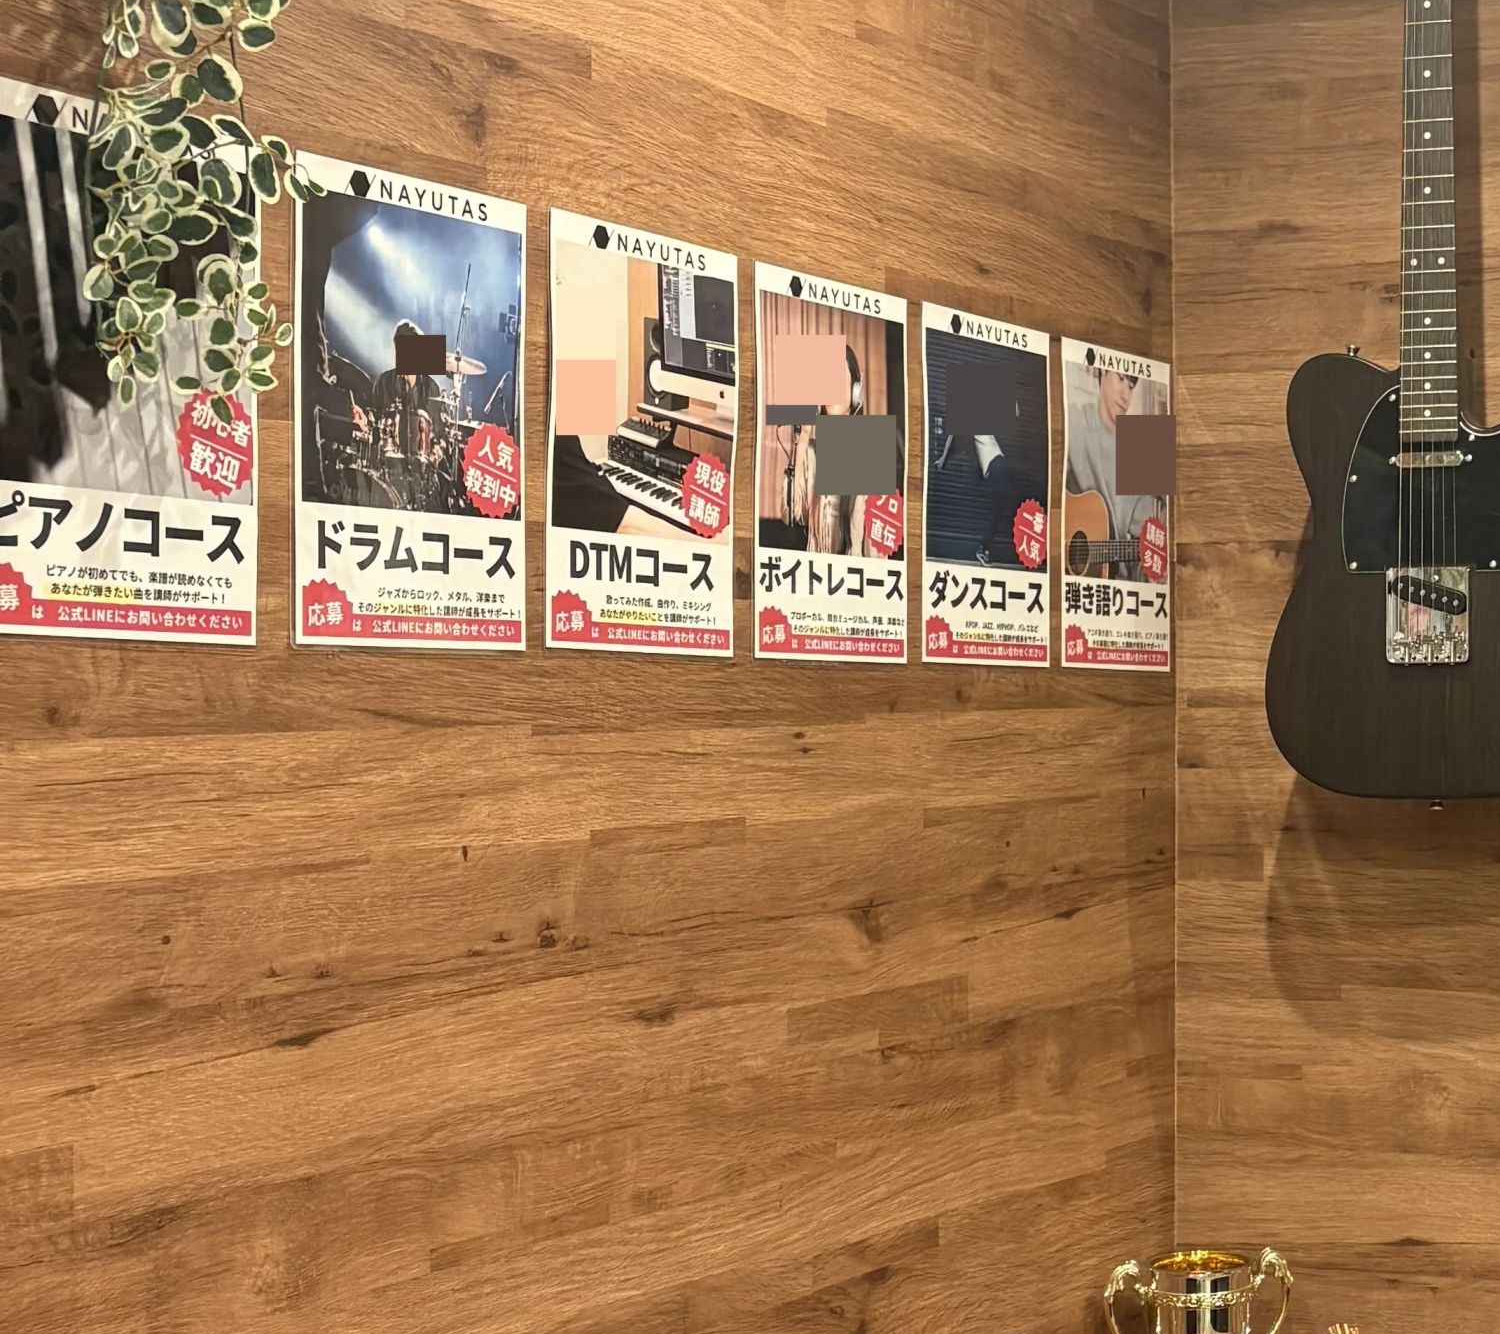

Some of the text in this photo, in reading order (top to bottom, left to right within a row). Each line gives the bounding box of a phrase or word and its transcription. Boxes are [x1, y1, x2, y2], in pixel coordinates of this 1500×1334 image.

[380, 179, 488, 221] NAYUTAS
[617, 233, 706, 271] NAYUTAS
[809, 283, 880, 314] NAYUTAS
[967, 320, 1027, 348] NAYUTAS
[1100, 352, 1151, 377] NAYUTAS
[190, 440, 241, 489] 歓迎
[477, 435, 515, 472] 人気
[464, 466, 517, 508] 殺到中
[694, 460, 726, 496] 現役
[688, 494, 720, 529] 講師
[317, 519, 516, 579] ドラムコース
[871, 518, 897, 549] 直伝
[1018, 535, 1040, 563] 人気
[46, 564, 233, 588] ピアノが初めてでも、楽譜が読めなくても
[570, 540, 714, 592] DTMコース
[759, 556, 904, 601] ボイトレコース
[51, 583, 226, 605] あなたが弾きたい曲を講師がサポート！
[929, 570, 1044, 614] ダンスコース
[1065, 581, 1168, 619] 弾き語りコース
[32, 604, 44, 619] は
[58, 606, 243, 629] 公式LINEにお問い合わせください
[308, 601, 514, 637] 応募 は 公式LINEにお問い合わせください
[555, 610, 725, 645] 応募 は 公式LINEにお問い合わせください
[762, 624, 785, 645] 応募
[928, 631, 948, 650] 応募
